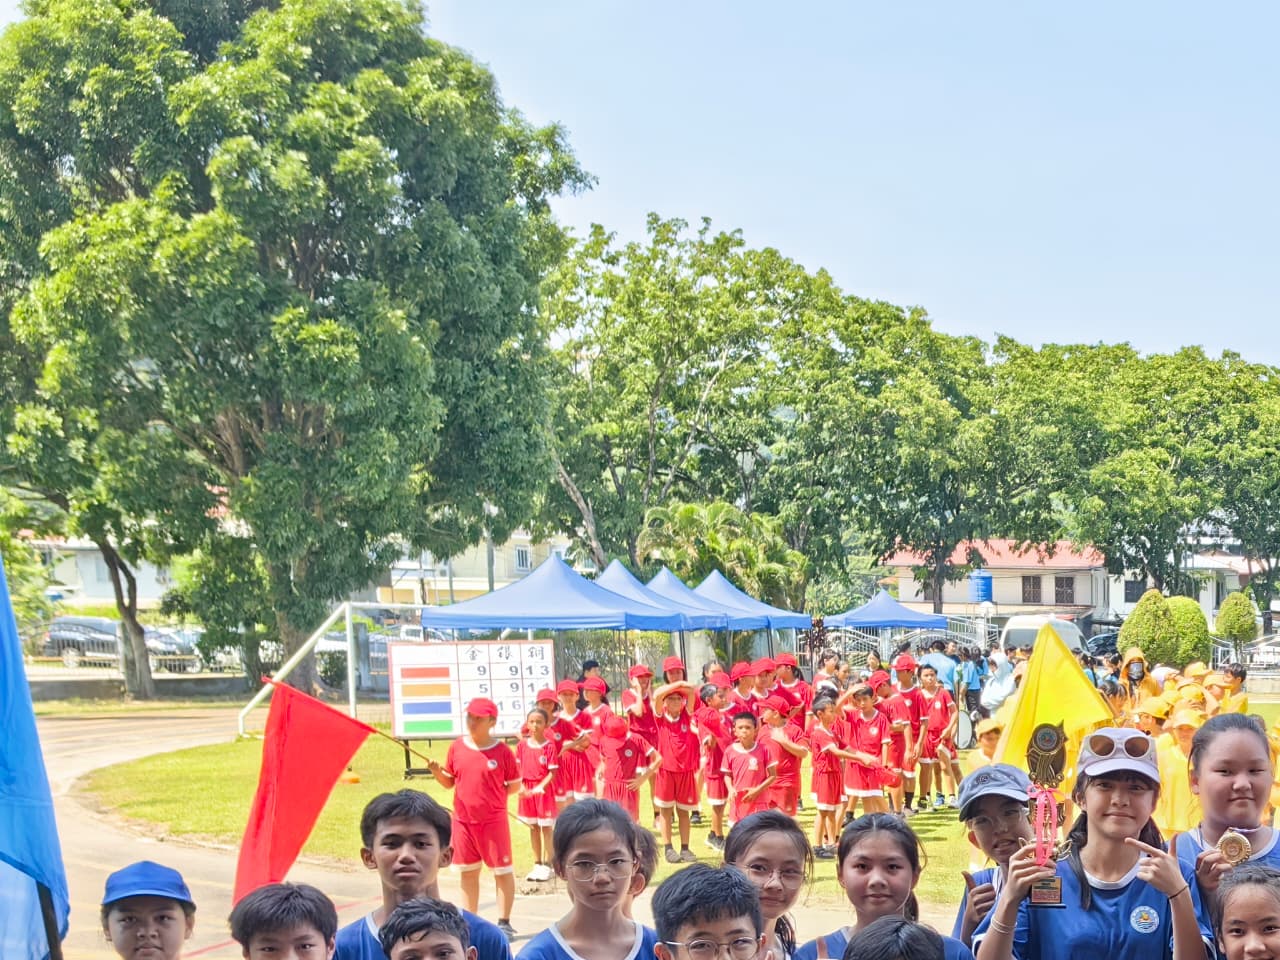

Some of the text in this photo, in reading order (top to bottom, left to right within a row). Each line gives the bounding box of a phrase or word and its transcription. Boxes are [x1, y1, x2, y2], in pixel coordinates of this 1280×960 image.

[465, 645, 483, 661] 金
[477, 665, 487, 676] 9
[509, 665, 519, 676] 9
[479, 683, 489, 694] 5
[510, 682, 520, 693] 9
